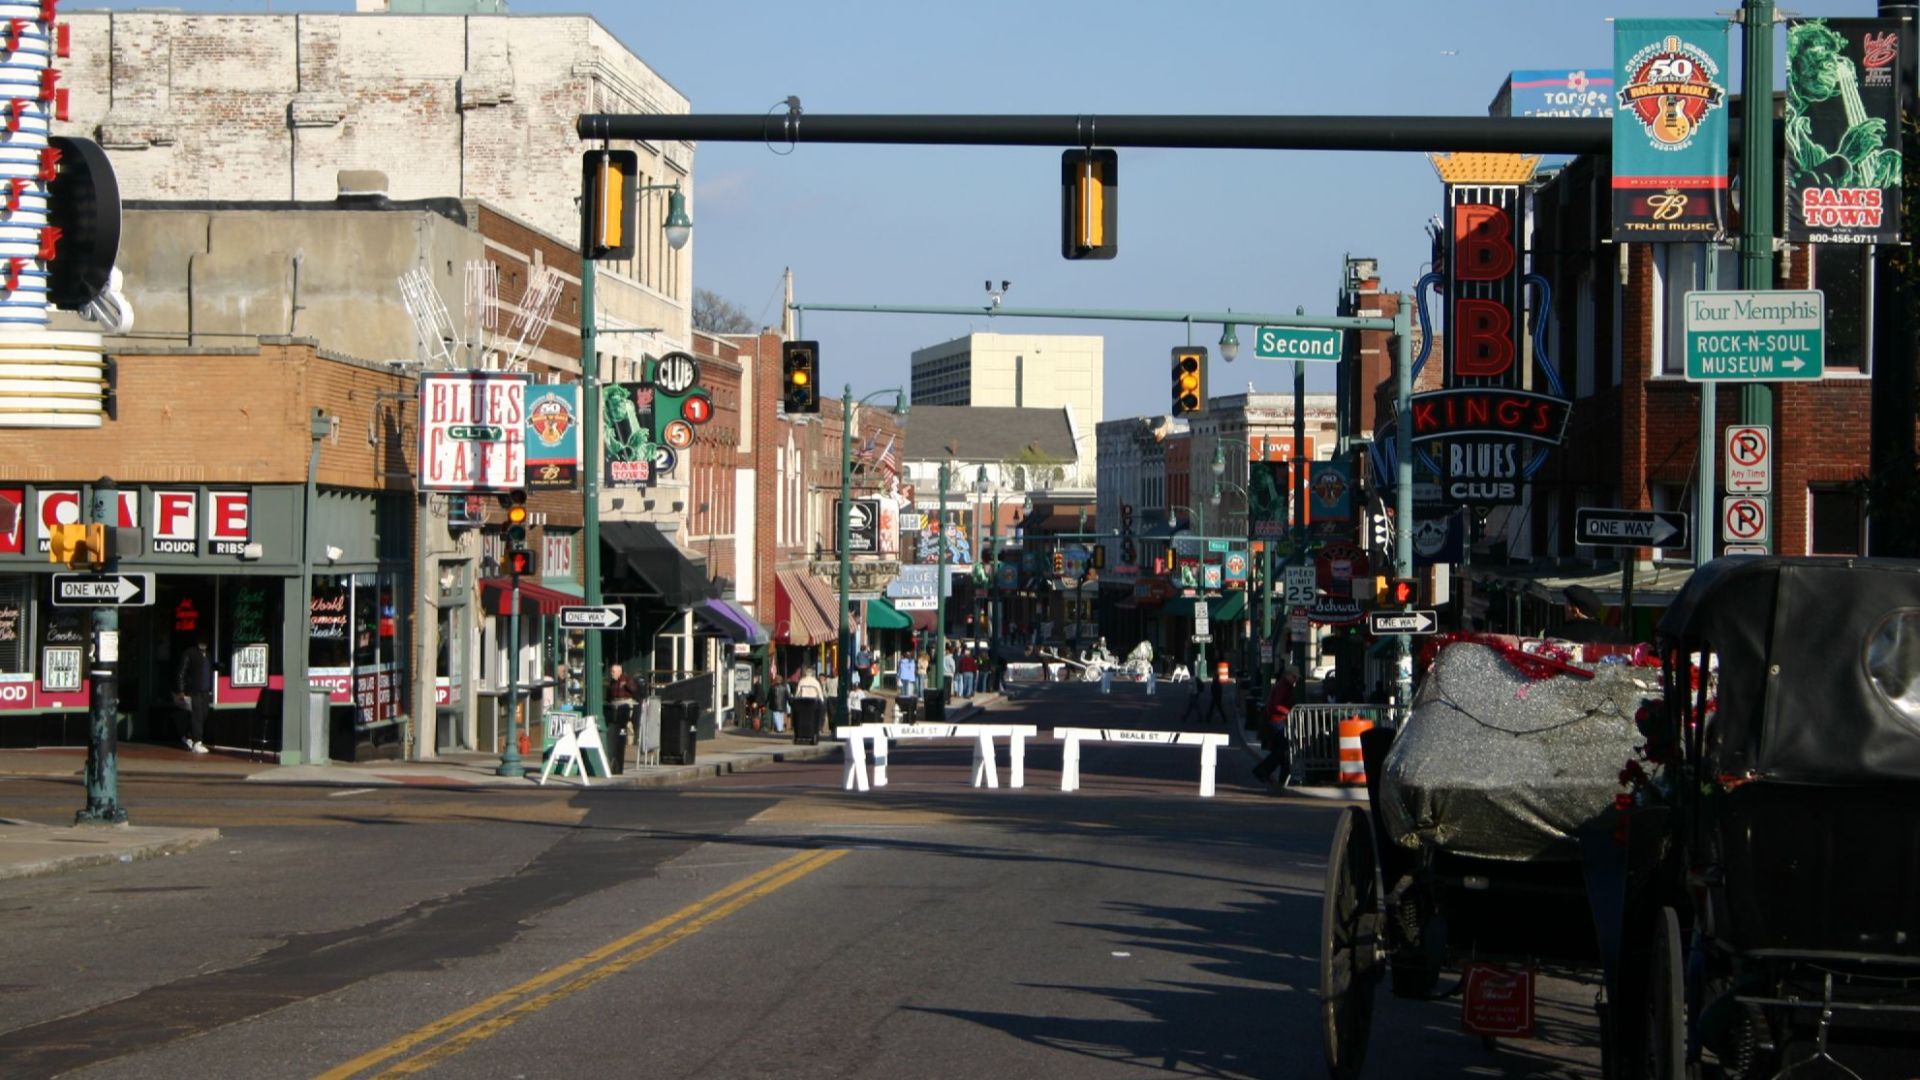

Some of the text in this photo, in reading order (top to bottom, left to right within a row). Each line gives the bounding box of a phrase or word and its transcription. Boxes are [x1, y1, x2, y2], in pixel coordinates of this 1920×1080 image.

[1649, 59, 1692, 77] 50
[1544, 91, 1607, 105] Target
[1804, 207, 1882, 226] TOWN
[1624, 222, 1714, 231] TRUE MUSIC
[1809, 233, 1878, 244] 800-456-0711
[1690, 299, 1817, 324] Tour Memphis
[1262, 332, 1334, 355] Second
[1697, 335, 1811, 353] ROCK-N-SOUL
[1702, 356, 1774, 374] MUSEUM
[659, 356, 694, 391] CLUB
[431, 383, 521, 424] BLUES
[1414, 397, 1551, 433] KING'S
[430, 427, 519, 483] CAFE
[1450, 443, 1517, 478] BLUES
[1731, 469, 1765, 479] Any Time
[1450, 483, 1516, 499] CLUB
[1590, 520, 1655, 536] ONE WAY
[154, 541, 196, 553] LIQUOR
[217, 542, 245, 554] RIBS
[1288, 569, 1313, 577] SPEED
[65, 583, 118, 596] ONE WAY
[1288, 586, 1314, 600] 25
[568, 612, 605, 621] ONE WAY
[1379, 617, 1417, 628] ONE WAY
